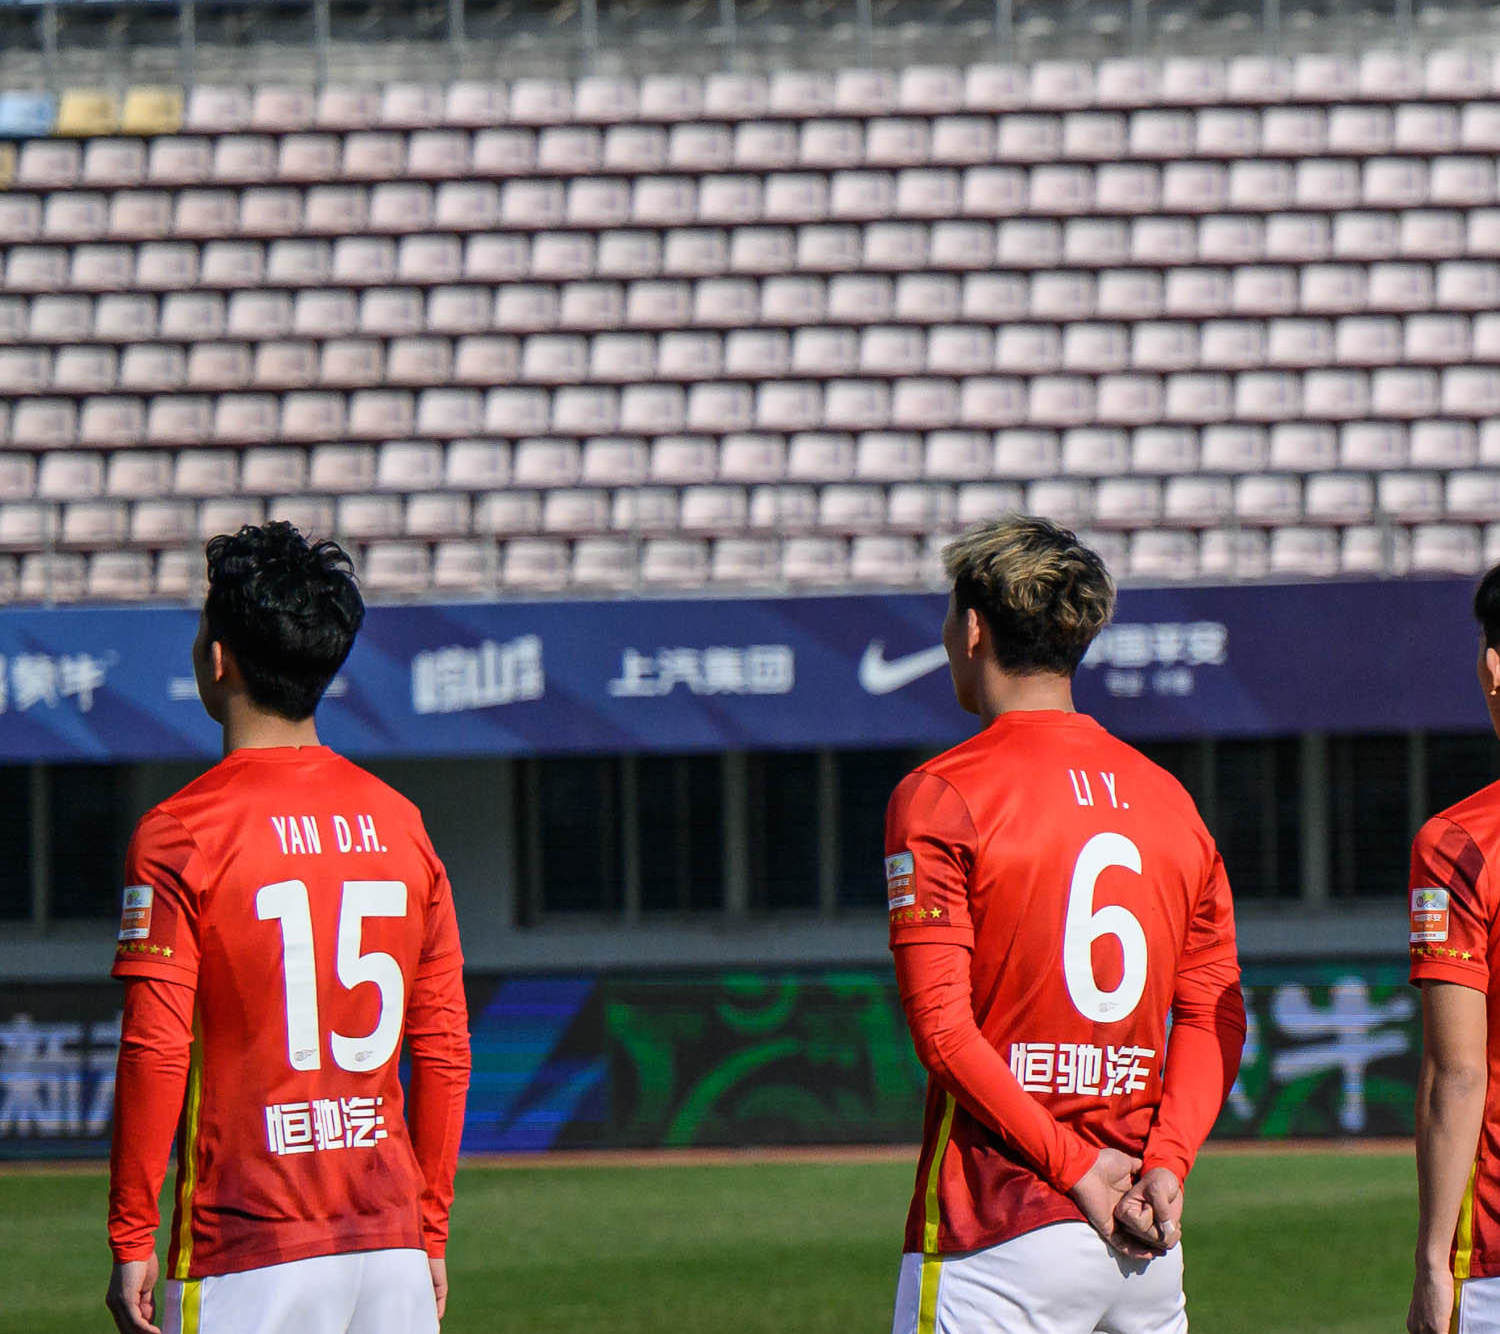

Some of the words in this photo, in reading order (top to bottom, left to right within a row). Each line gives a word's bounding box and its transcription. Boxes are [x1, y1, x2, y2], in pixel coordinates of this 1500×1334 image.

[271, 816, 322, 855] YAN
[333, 814, 388, 854] D.H.
[1069, 769, 1095, 807] LI
[1100, 771, 1130, 809] Y.
[256, 879, 408, 1073] 15
[1064, 832, 1148, 1024] 6
